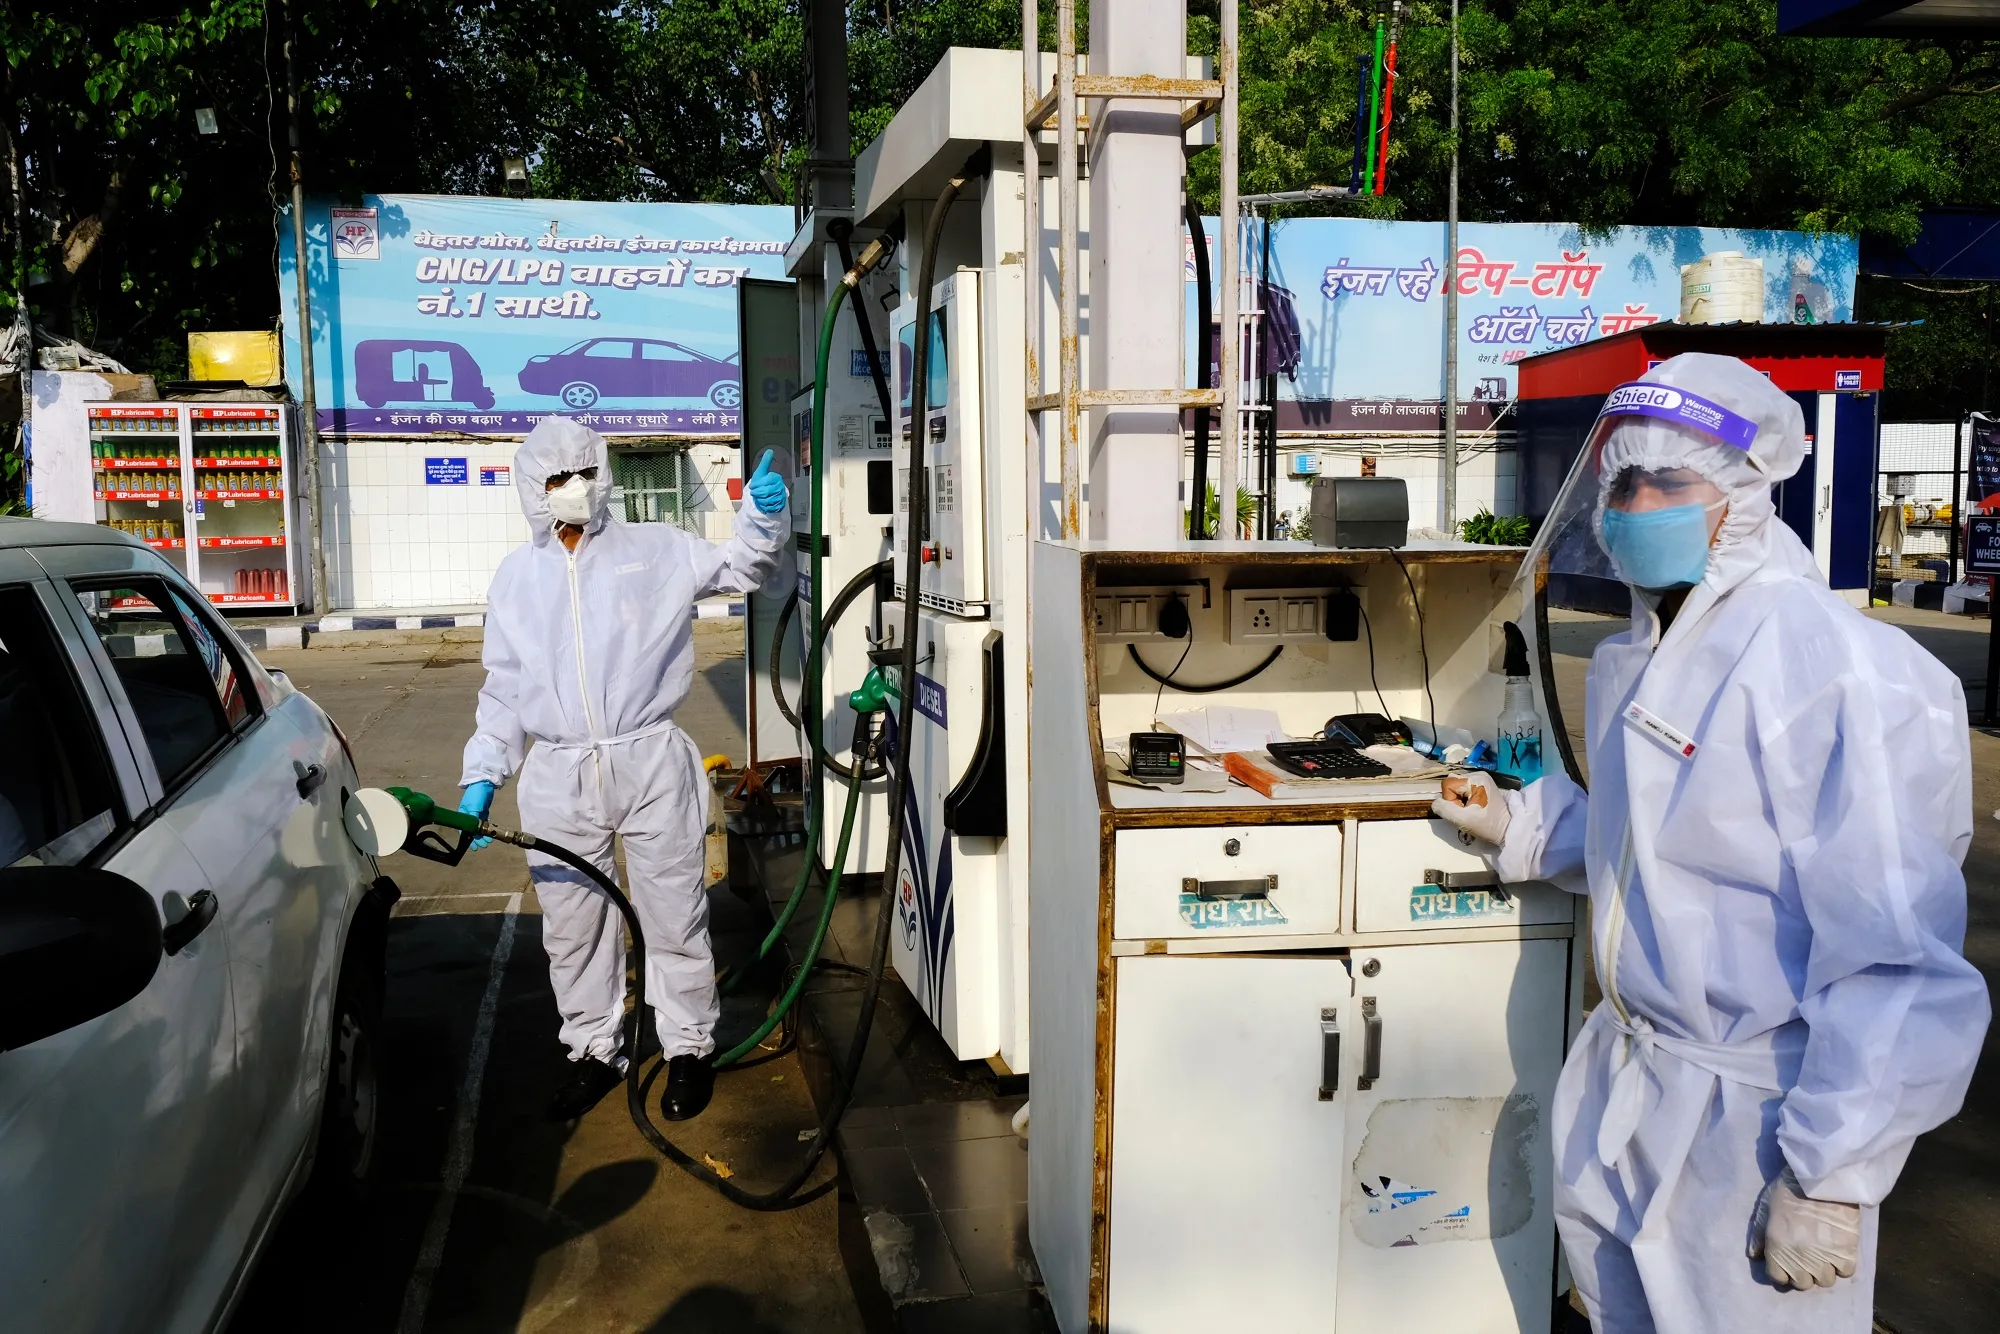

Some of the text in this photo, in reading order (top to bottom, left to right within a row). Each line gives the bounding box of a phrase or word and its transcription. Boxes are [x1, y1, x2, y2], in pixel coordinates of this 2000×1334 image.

[345, 226, 366, 236] HP
[414, 230, 476, 250] बेहतर
[537, 232, 625, 253] बेहतरीन
[627, 235, 681, 254] इंजन
[416, 257, 750, 289] CNG/LPG वाहनों का
[1321, 258, 1394, 300] इंजन
[1397, 257, 1439, 302] रहे
[495, 290, 601, 320] साथी.
[1468, 305, 1543, 344] ऑटो
[1543, 305, 1597, 344] चले
[1351, 402, 1376, 417] इंजन
[1379, 402, 1392, 416] की
[1396, 405, 1437, 416] लाजवाब
[1612, 389, 1669, 405] Shield
[1685, 398, 1724, 420] Warning:
[390, 412, 422, 425] इंजन
[426, 412, 444, 425] की
[447, 414, 467, 425] उम्र
[576, 412, 599, 425] और
[603, 415, 632, 425] पावर
[636, 412, 668, 427] सुधारे
[692, 412, 716, 425] लंबी
[720, 412, 738, 427] ड्रेन
[920, 682, 943, 717] DIESEL
[903, 879, 912, 906] HP
